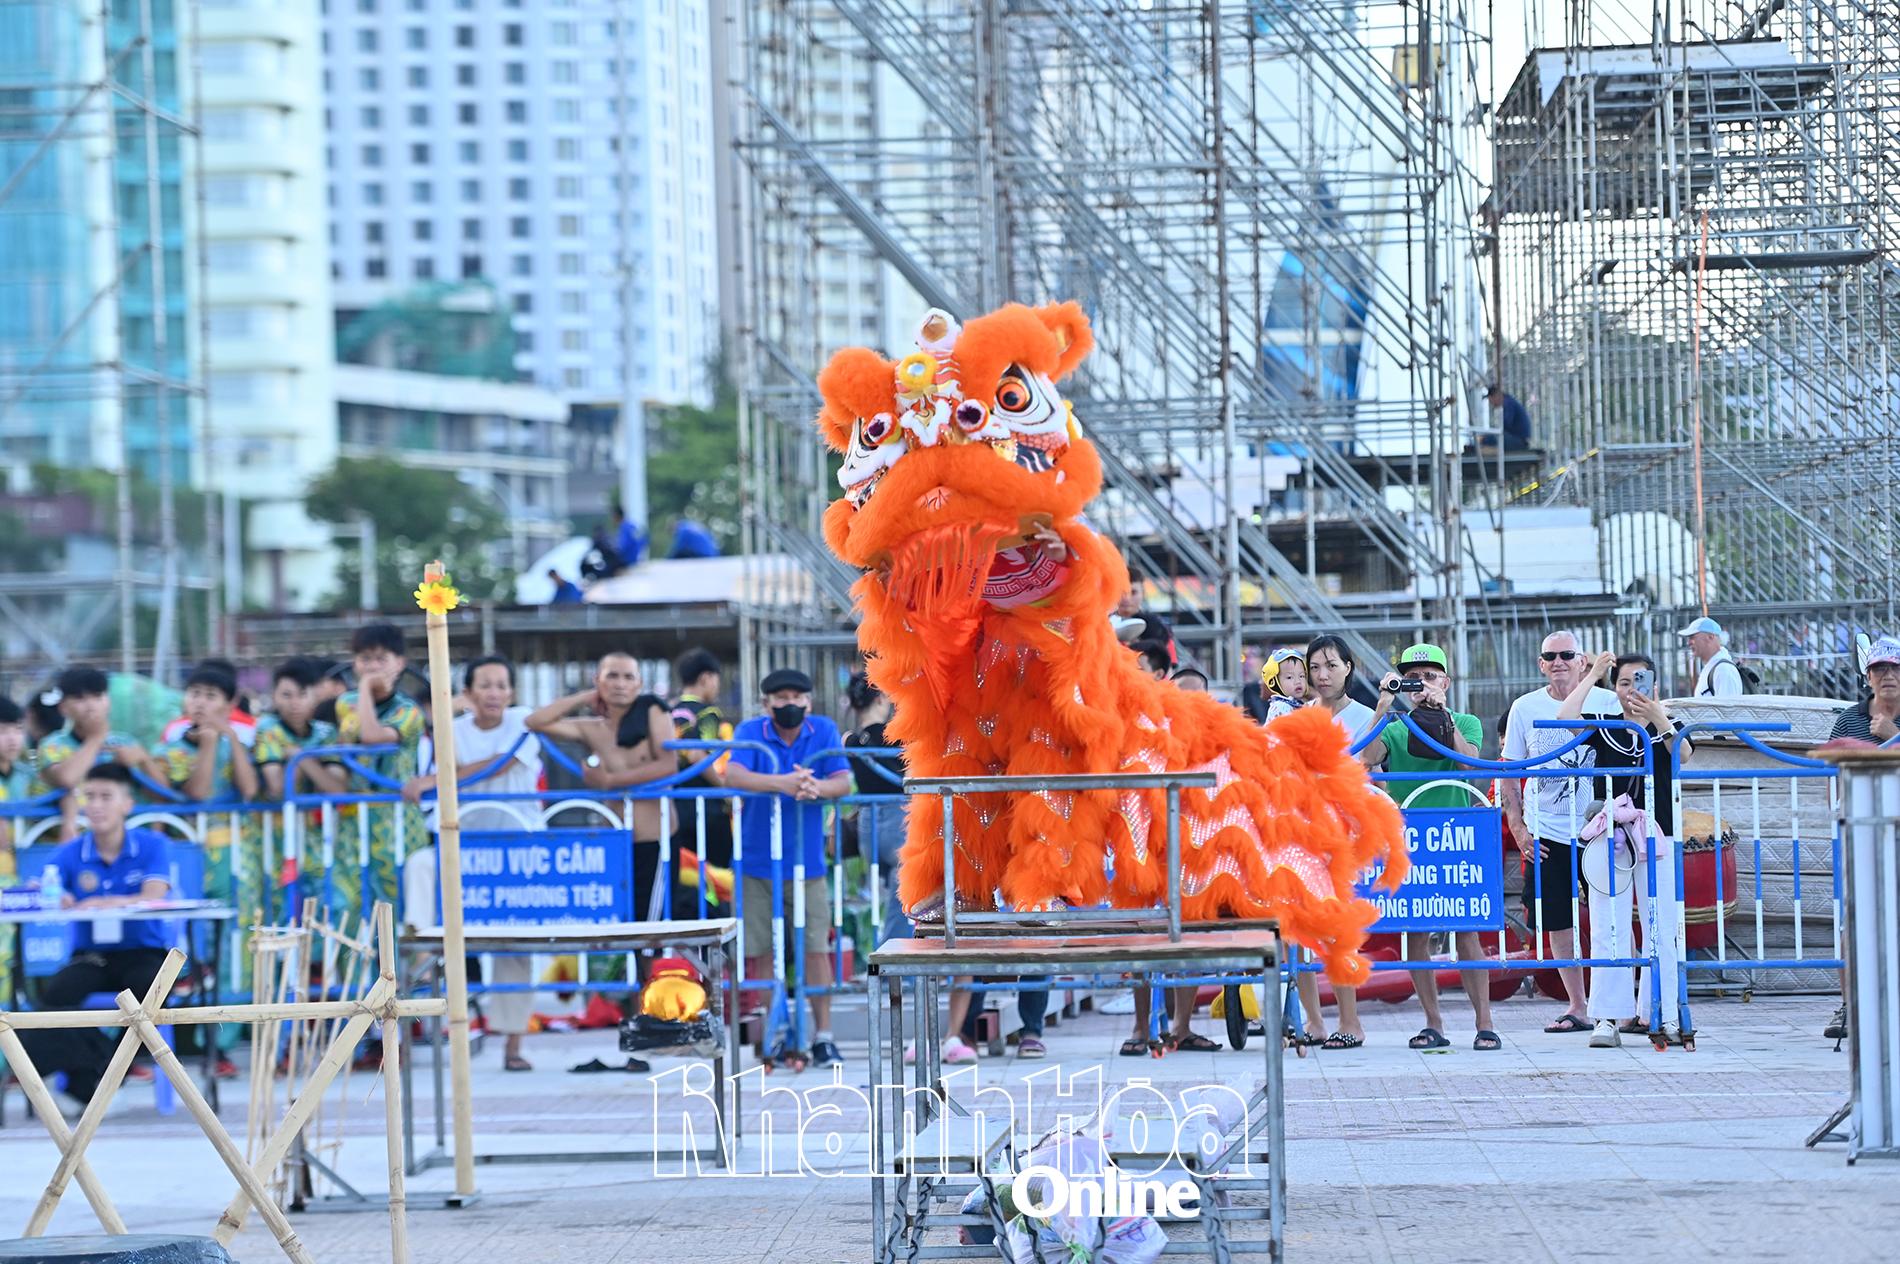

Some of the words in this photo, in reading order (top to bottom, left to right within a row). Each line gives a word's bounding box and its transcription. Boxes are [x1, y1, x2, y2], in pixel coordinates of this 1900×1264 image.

[1426, 818, 1475, 852] CẤM
[461, 847, 503, 875] KHU
[1442, 860, 1484, 887] TIỆN
[1412, 893, 1466, 918] ĐƯỜNG
[1470, 893, 1491, 920] BỘ
